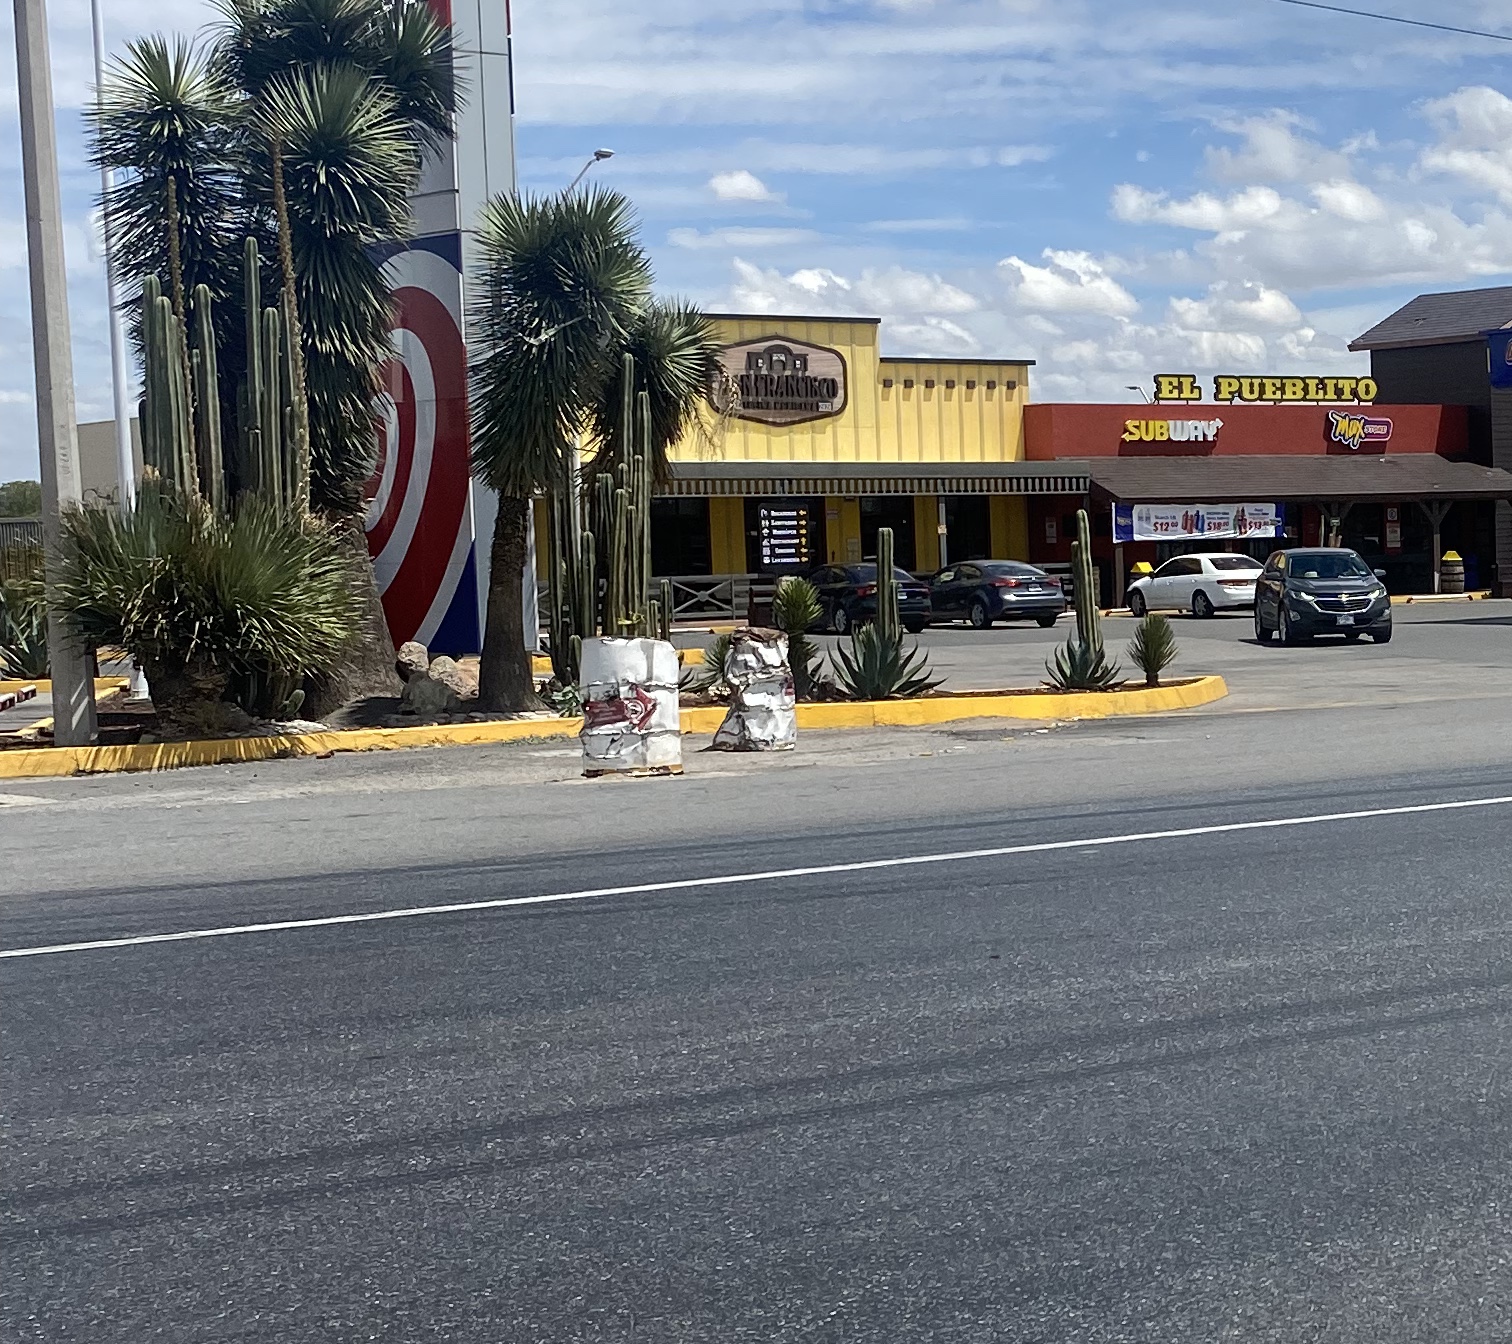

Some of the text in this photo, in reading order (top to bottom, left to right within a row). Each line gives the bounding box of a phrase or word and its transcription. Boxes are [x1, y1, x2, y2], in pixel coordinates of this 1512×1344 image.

[753, 374, 839, 399] FRANCISCO
[1156, 376, 1377, 401] EL PUEBLITO
[1122, 419, 1223, 442] SUBWAY
